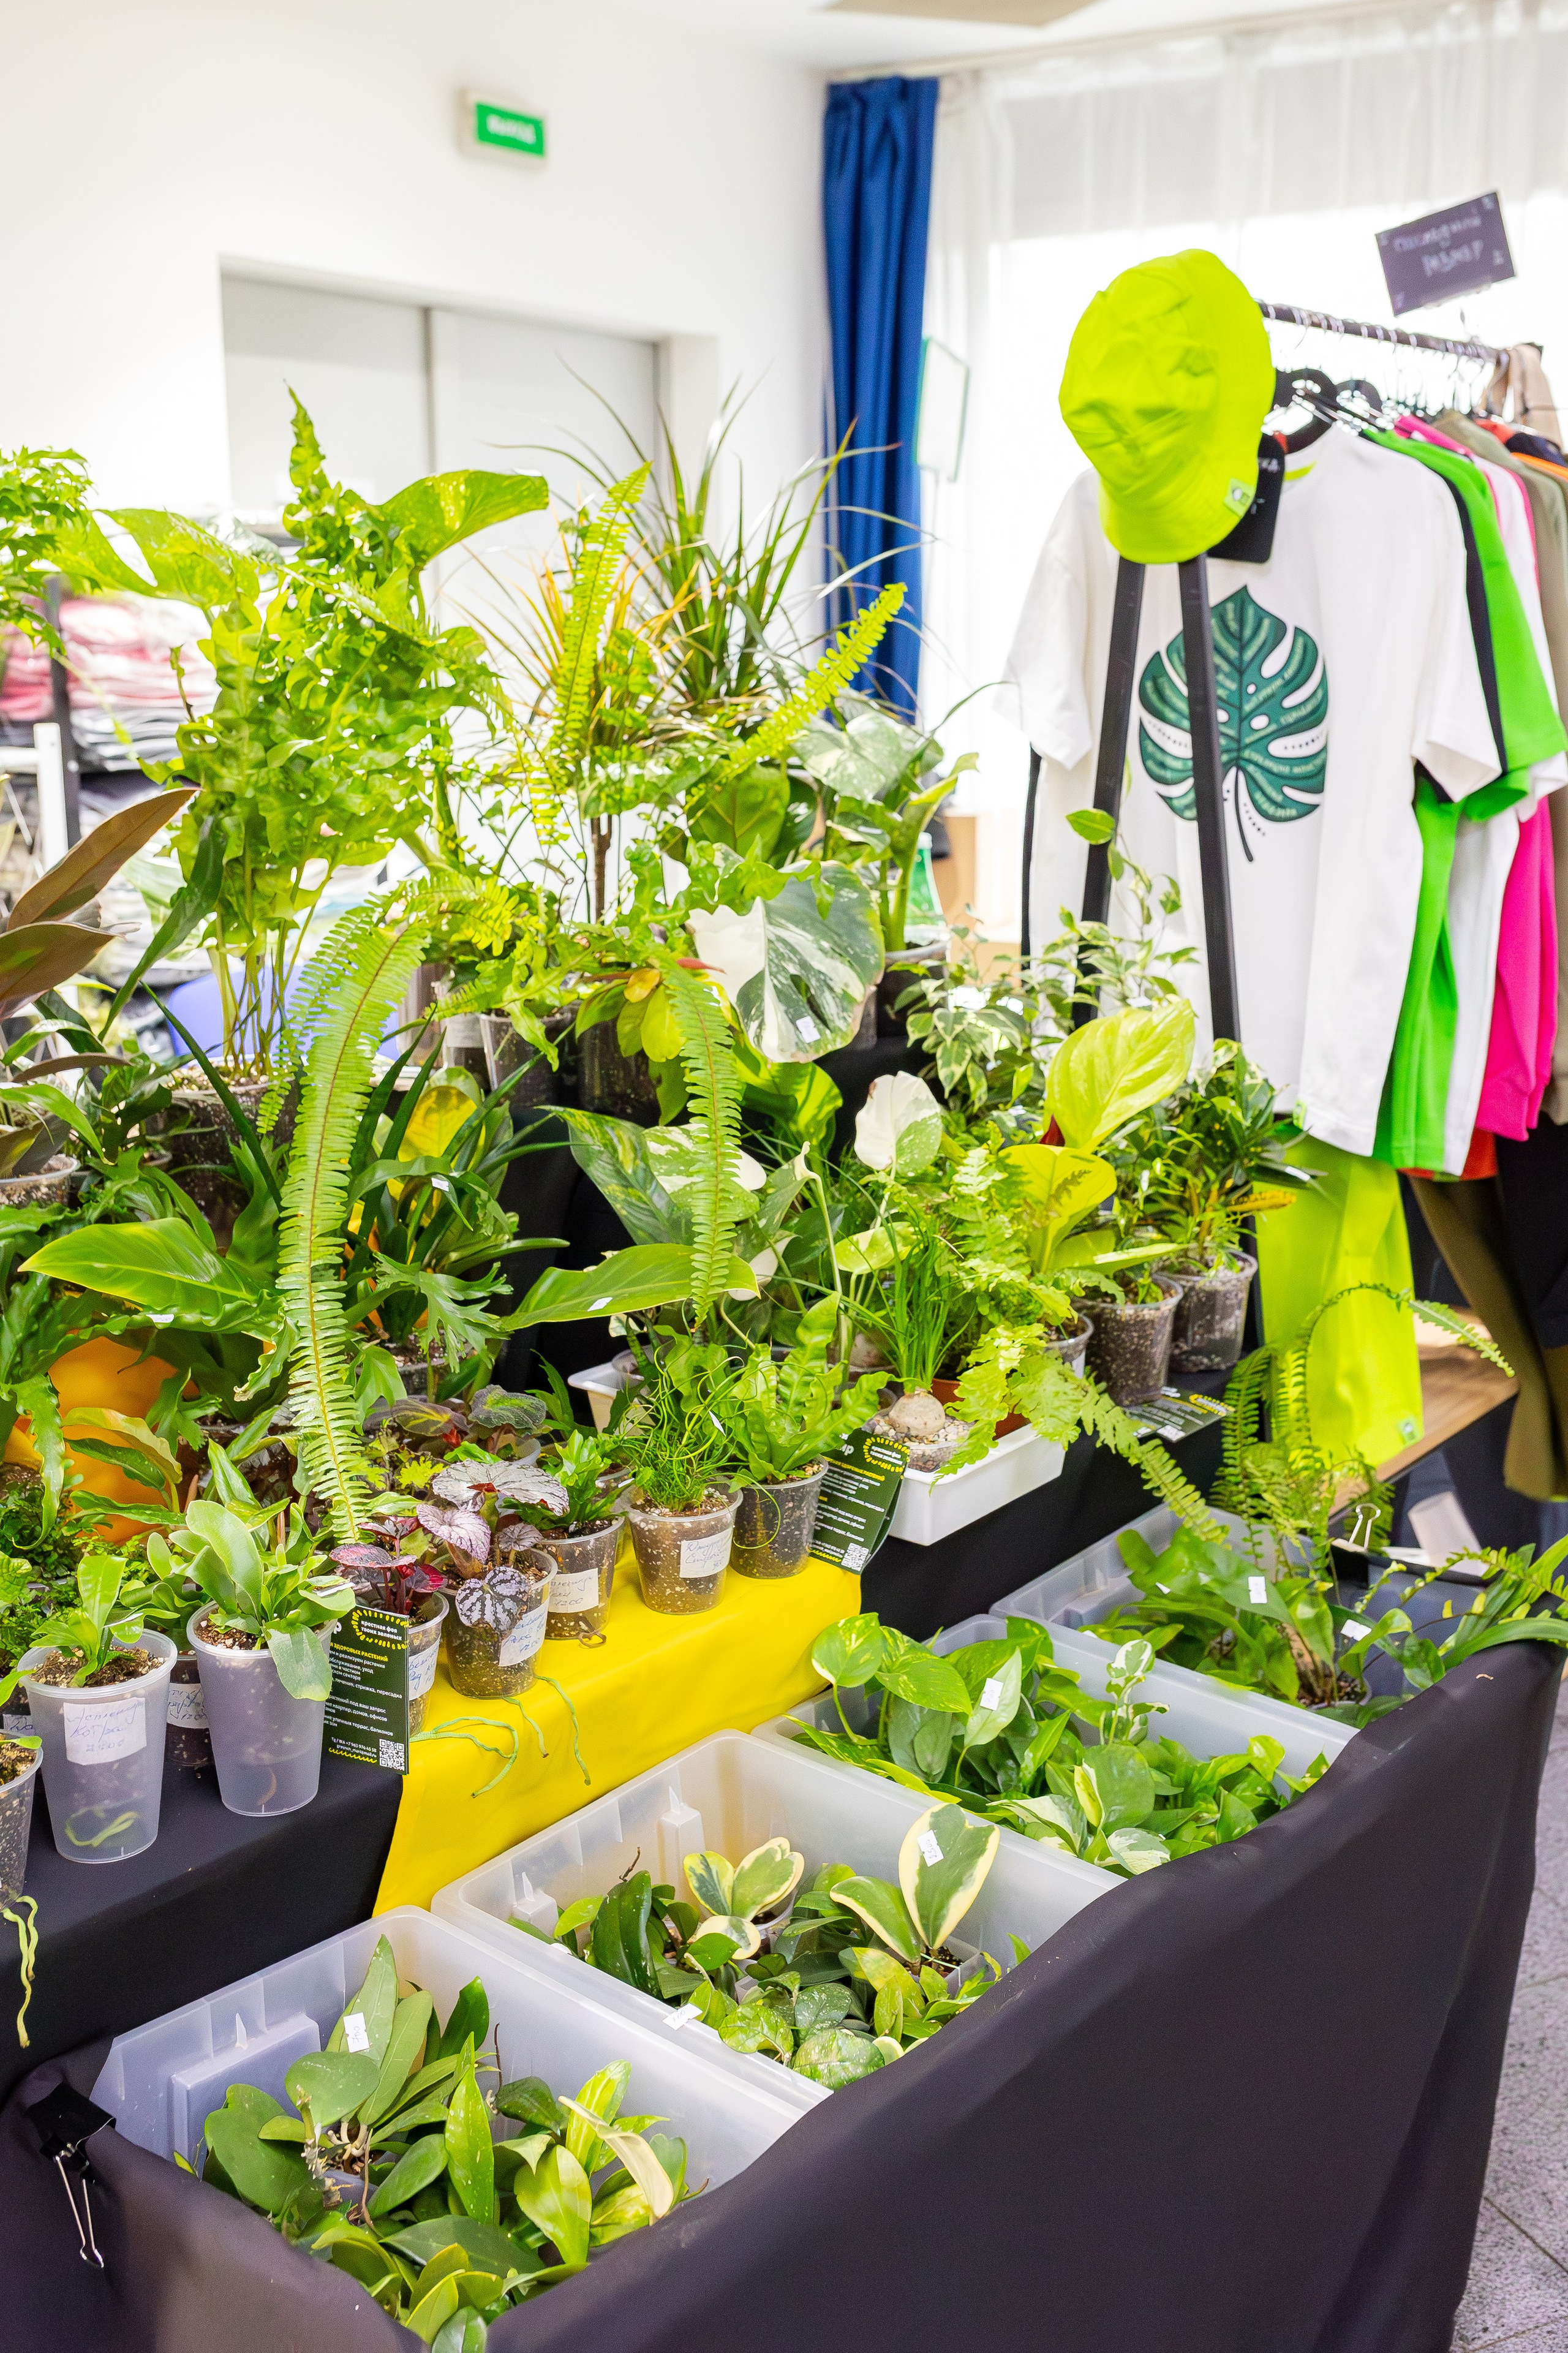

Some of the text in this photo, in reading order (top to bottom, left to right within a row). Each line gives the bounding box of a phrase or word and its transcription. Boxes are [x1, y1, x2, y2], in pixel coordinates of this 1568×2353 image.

[361, 1620, 386, 1631] крестная
[361, 1626, 402, 1641] твоих зеленых
[333, 1642, 388, 1662] ЗДОРОВЫХ РАСТЕНИЙ
[363, 1660, 385, 1669] растения
[342, 1672, 361, 1681] секторе
[376, 1690, 402, 1699] пересадка
[370, 1726, 394, 1736] балконов
